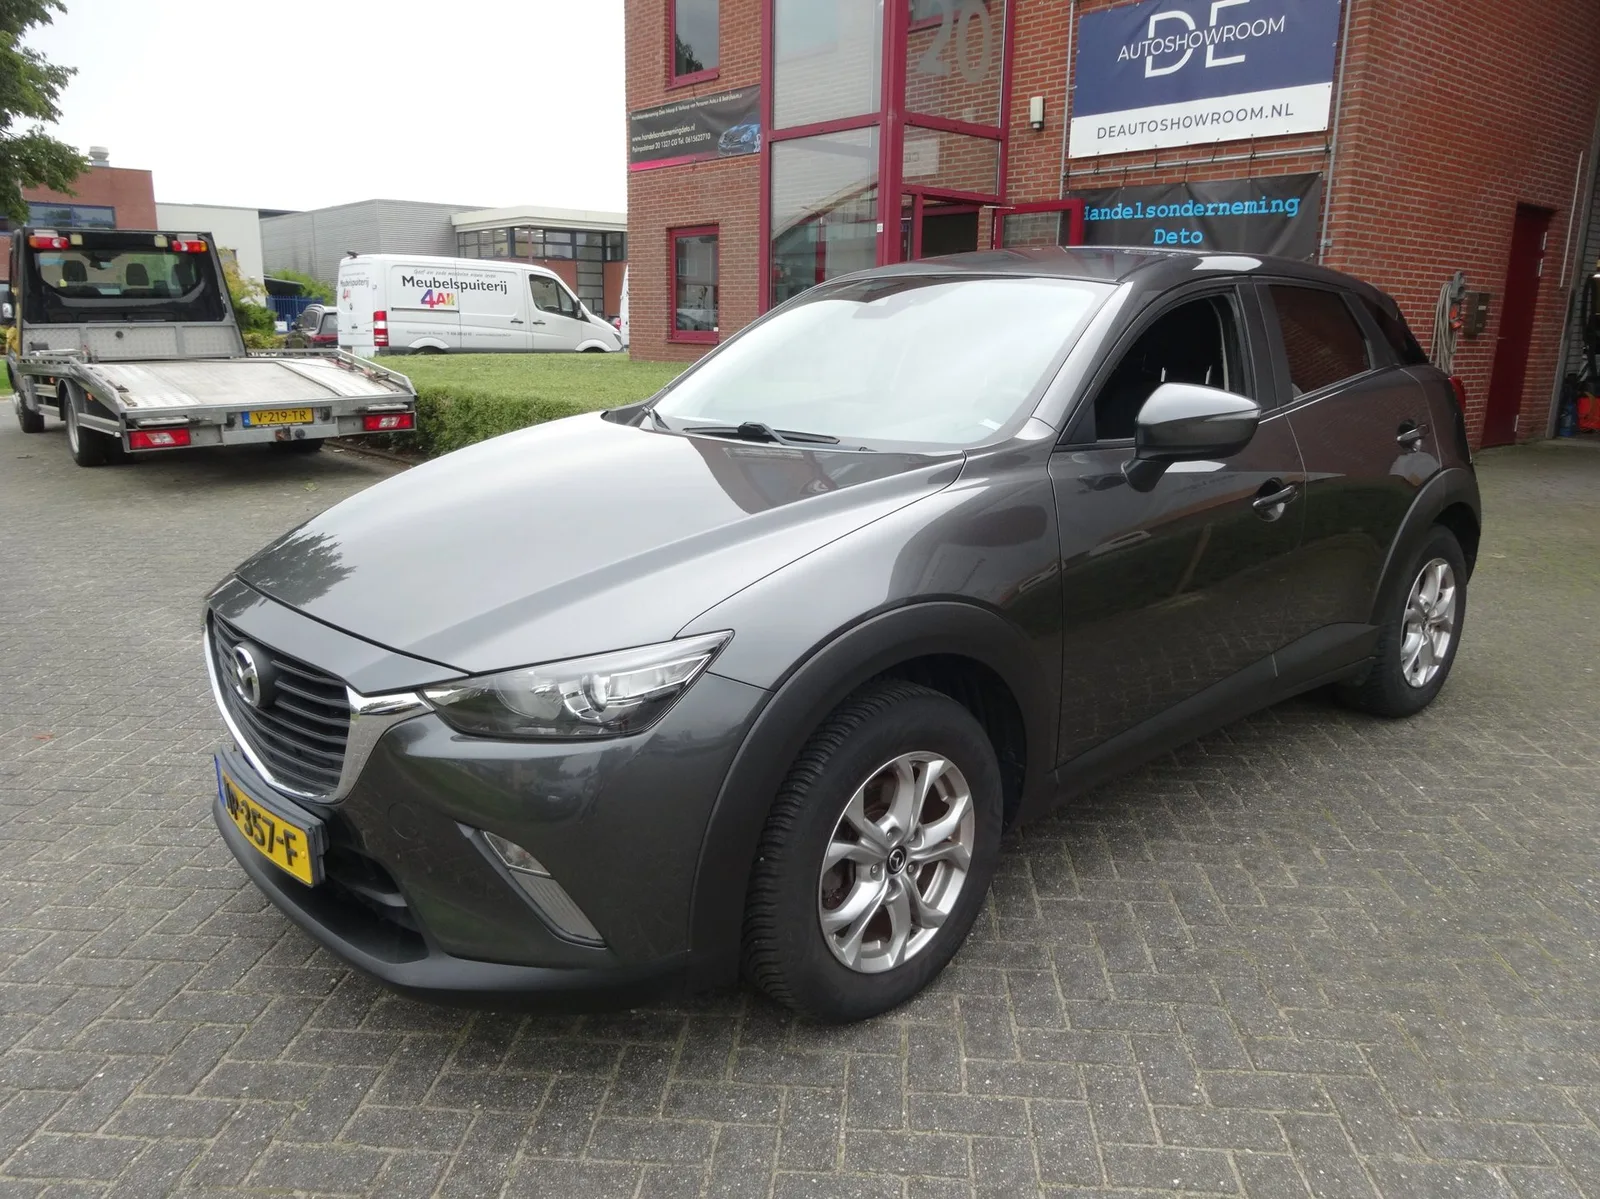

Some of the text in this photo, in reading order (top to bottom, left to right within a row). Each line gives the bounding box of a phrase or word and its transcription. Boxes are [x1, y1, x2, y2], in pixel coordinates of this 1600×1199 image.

[1117, 15, 1286, 62] AUTOSHOWROOM
[1097, 103, 1294, 140] DEAUTOSHOWROOM.NL
[1153, 228, 1203, 245] Deto
[402, 275, 508, 296] Meubelspuiterij
[256, 410, 307, 422] V-219-TR
